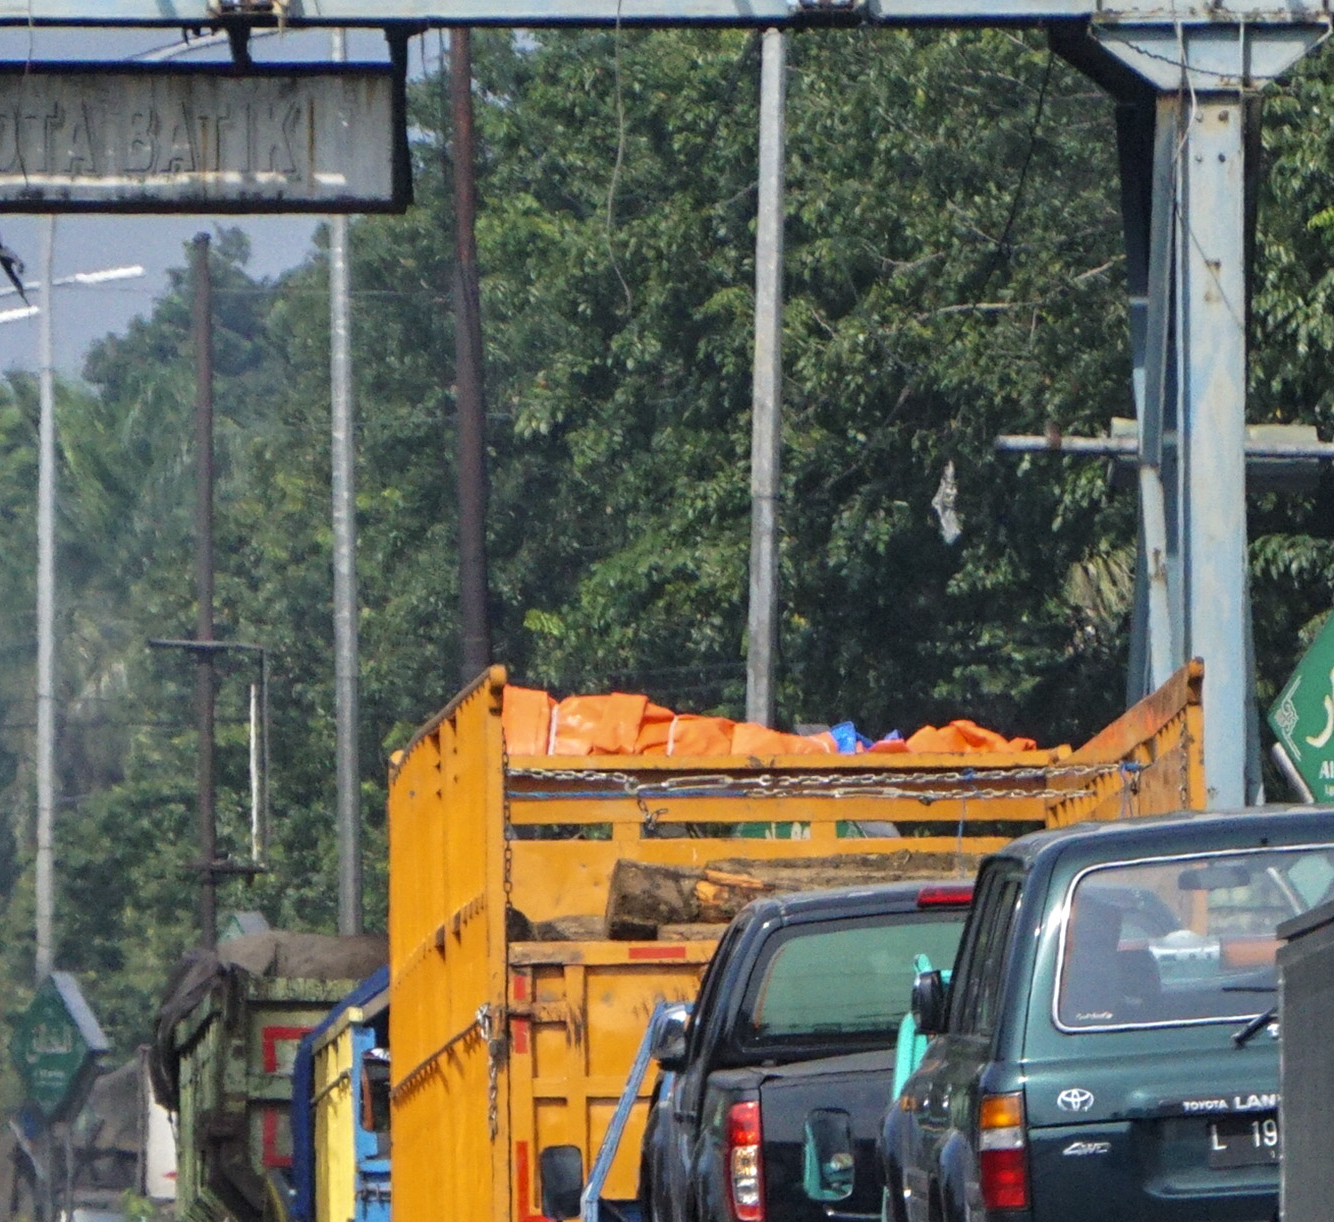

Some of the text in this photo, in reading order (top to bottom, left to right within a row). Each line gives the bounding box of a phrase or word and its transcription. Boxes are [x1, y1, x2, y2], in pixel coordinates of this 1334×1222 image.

[121, 100, 303, 174] BATIK
[1318, 760, 1334, 779] Al
[1183, 1099, 1229, 1112] TOYOTA
[1211, 1118, 1278, 1151] L 19
